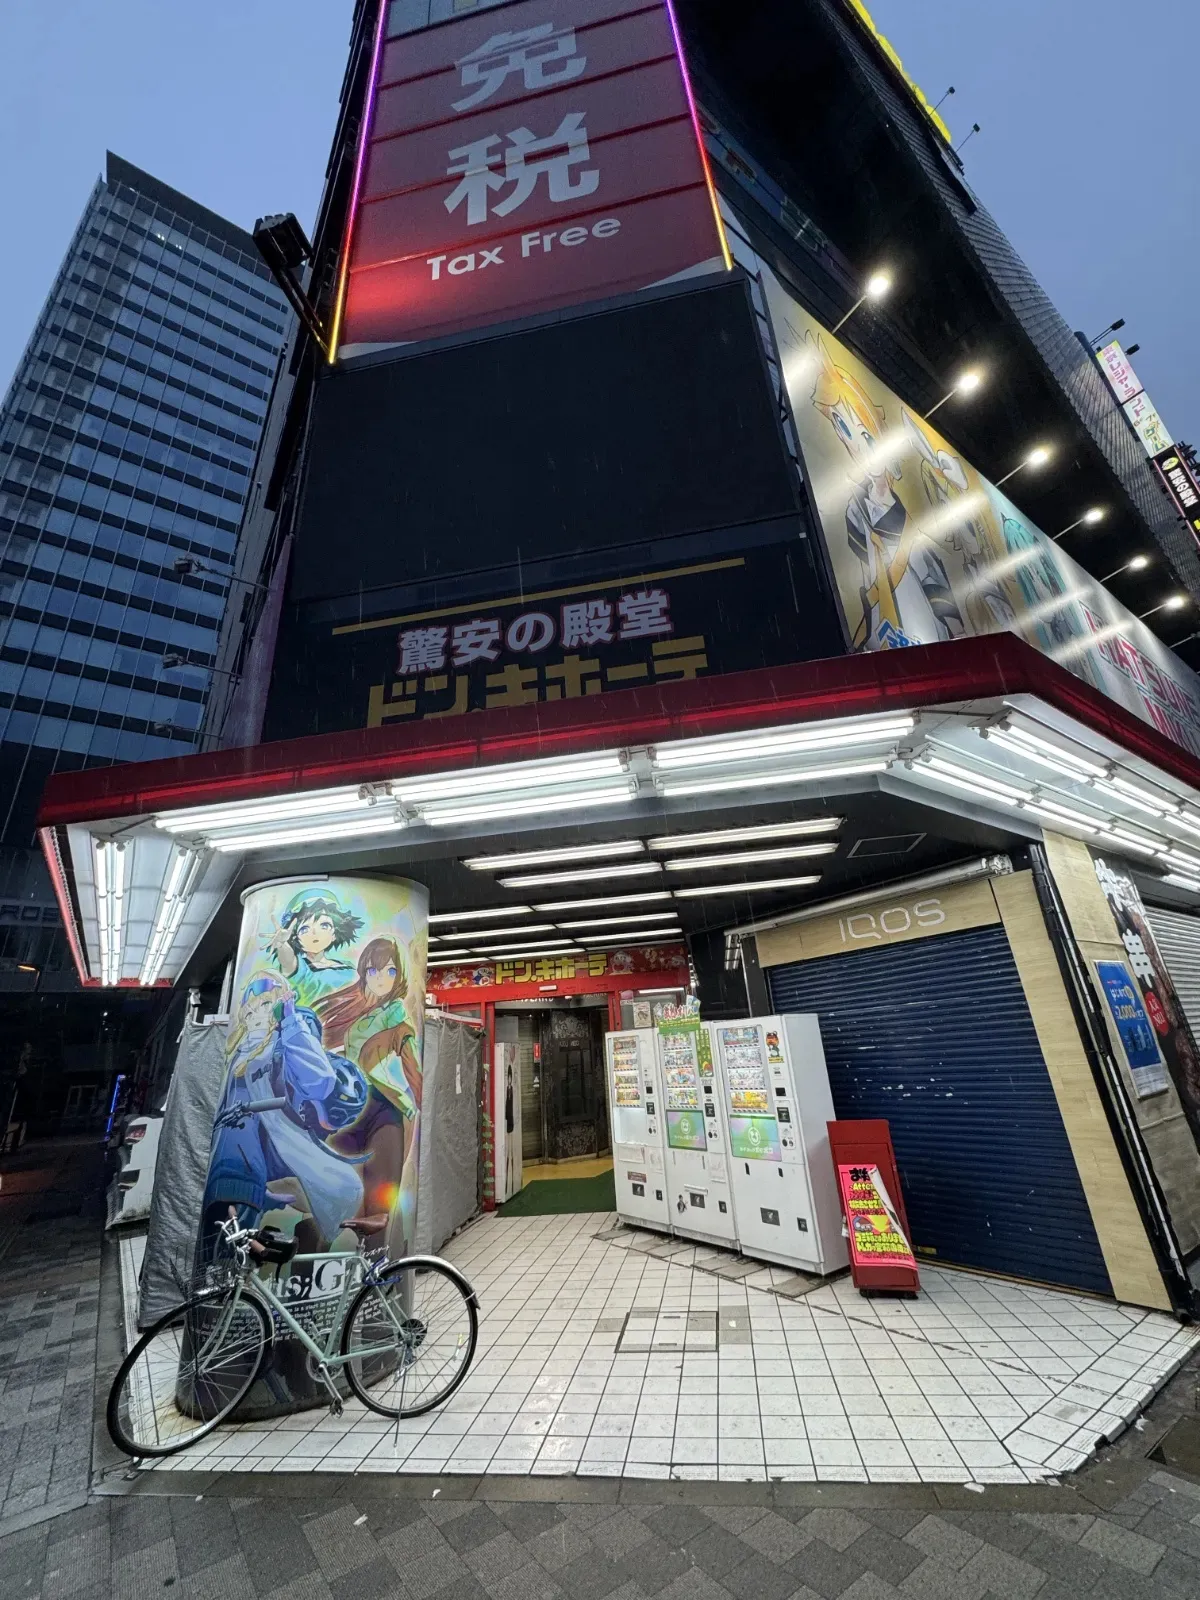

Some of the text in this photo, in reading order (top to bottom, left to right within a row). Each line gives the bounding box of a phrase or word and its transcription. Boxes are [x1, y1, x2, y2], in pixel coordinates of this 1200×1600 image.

[444, 22, 600, 227] 免税
[426, 216, 622, 281] Tax Free
[397, 588, 674, 675] 驚安の殿堂
[838, 898, 946, 942] IQOS
